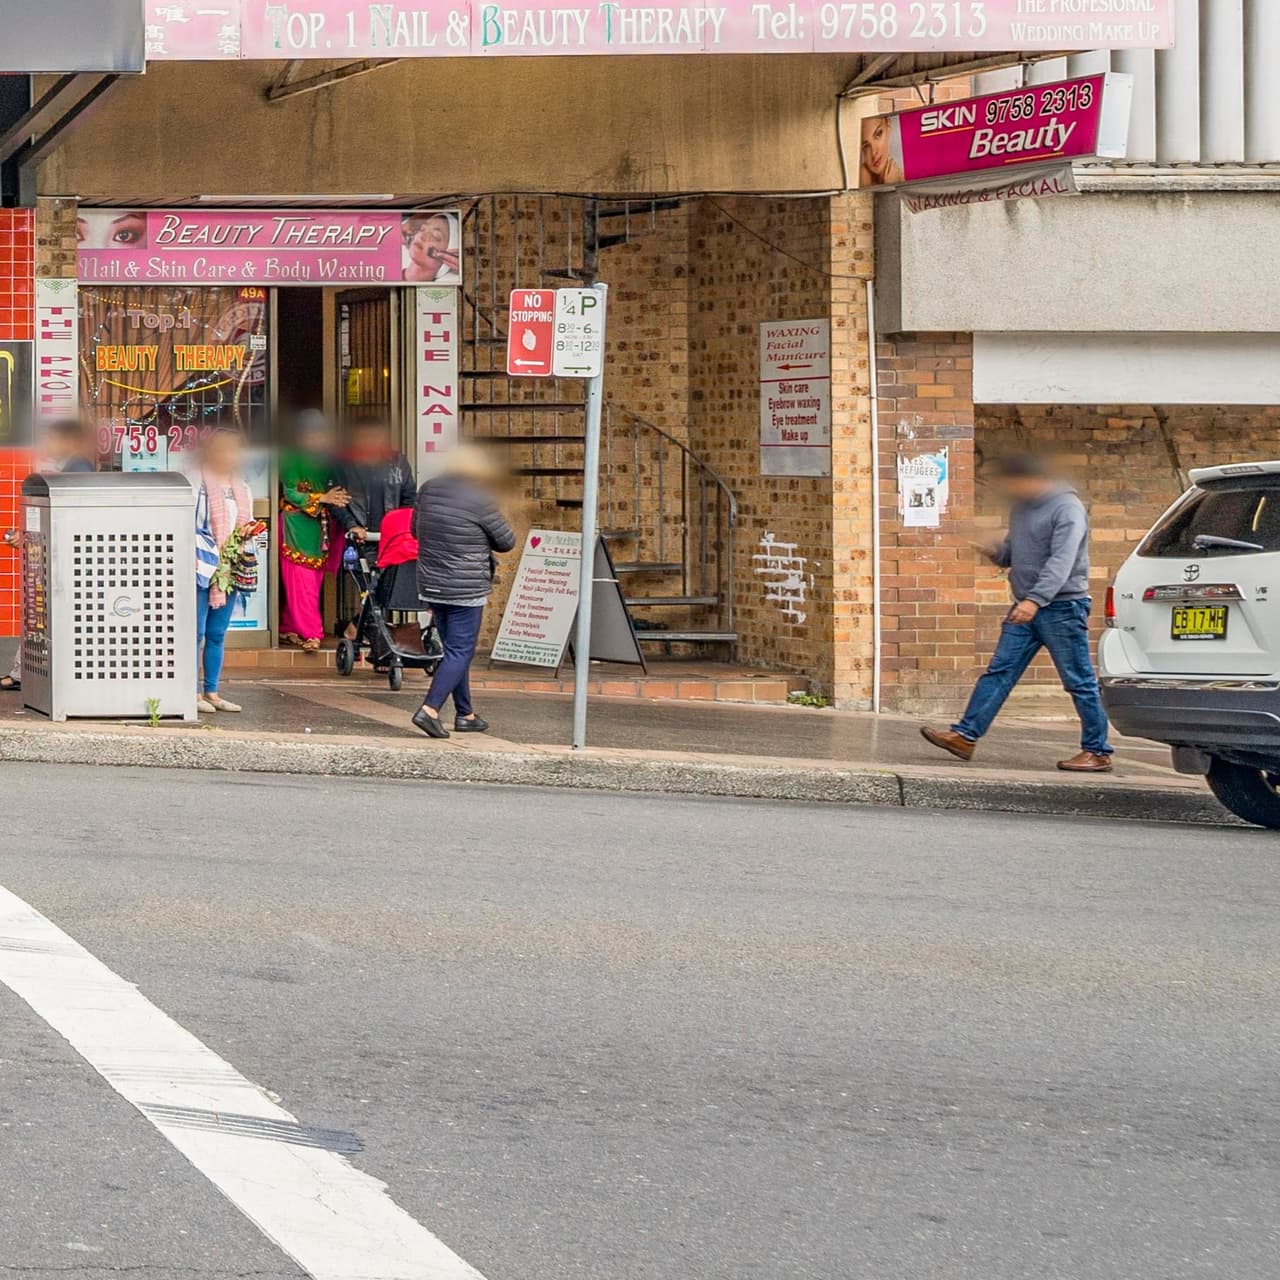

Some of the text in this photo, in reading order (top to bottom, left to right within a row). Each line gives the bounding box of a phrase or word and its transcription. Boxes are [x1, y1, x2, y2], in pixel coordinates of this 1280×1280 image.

[446, 10, 469, 48] &
[751, 4, 806, 40] Tel:
[821, 2, 899, 40] 9758
[909, 1, 987, 39] 2313
[920, 82, 1094, 132] SKIN 9758 2313
[968, 117, 1078, 159] Beauty
[995, 177, 1069, 200] FACIAL
[155, 215, 394, 246] BEAUTY THERAPY
[78, 256, 386, 283] Nail & Skin Care & Body Waxing
[239, 287, 266, 299] 49A
[524, 295, 542, 308] NO
[511, 310, 553, 322] STOPPING
[581, 295, 597, 316] P
[127, 308, 192, 334] Top.1
[422, 312, 452, 362] THE
[766, 326, 821, 339] WAXING
[766, 339, 804, 351] Facial
[95, 344, 247, 372] BEAUTY THERAPY
[765, 351, 827, 363] Manicure
[778, 382, 809, 395] Skin care
[768, 396, 821, 413] Eyebrow waxing
[421, 385, 454, 453] NAIL
[772, 414, 818, 429] Eye treatment
[96, 424, 159, 455] 9758
[781, 429, 809, 444] Make up
